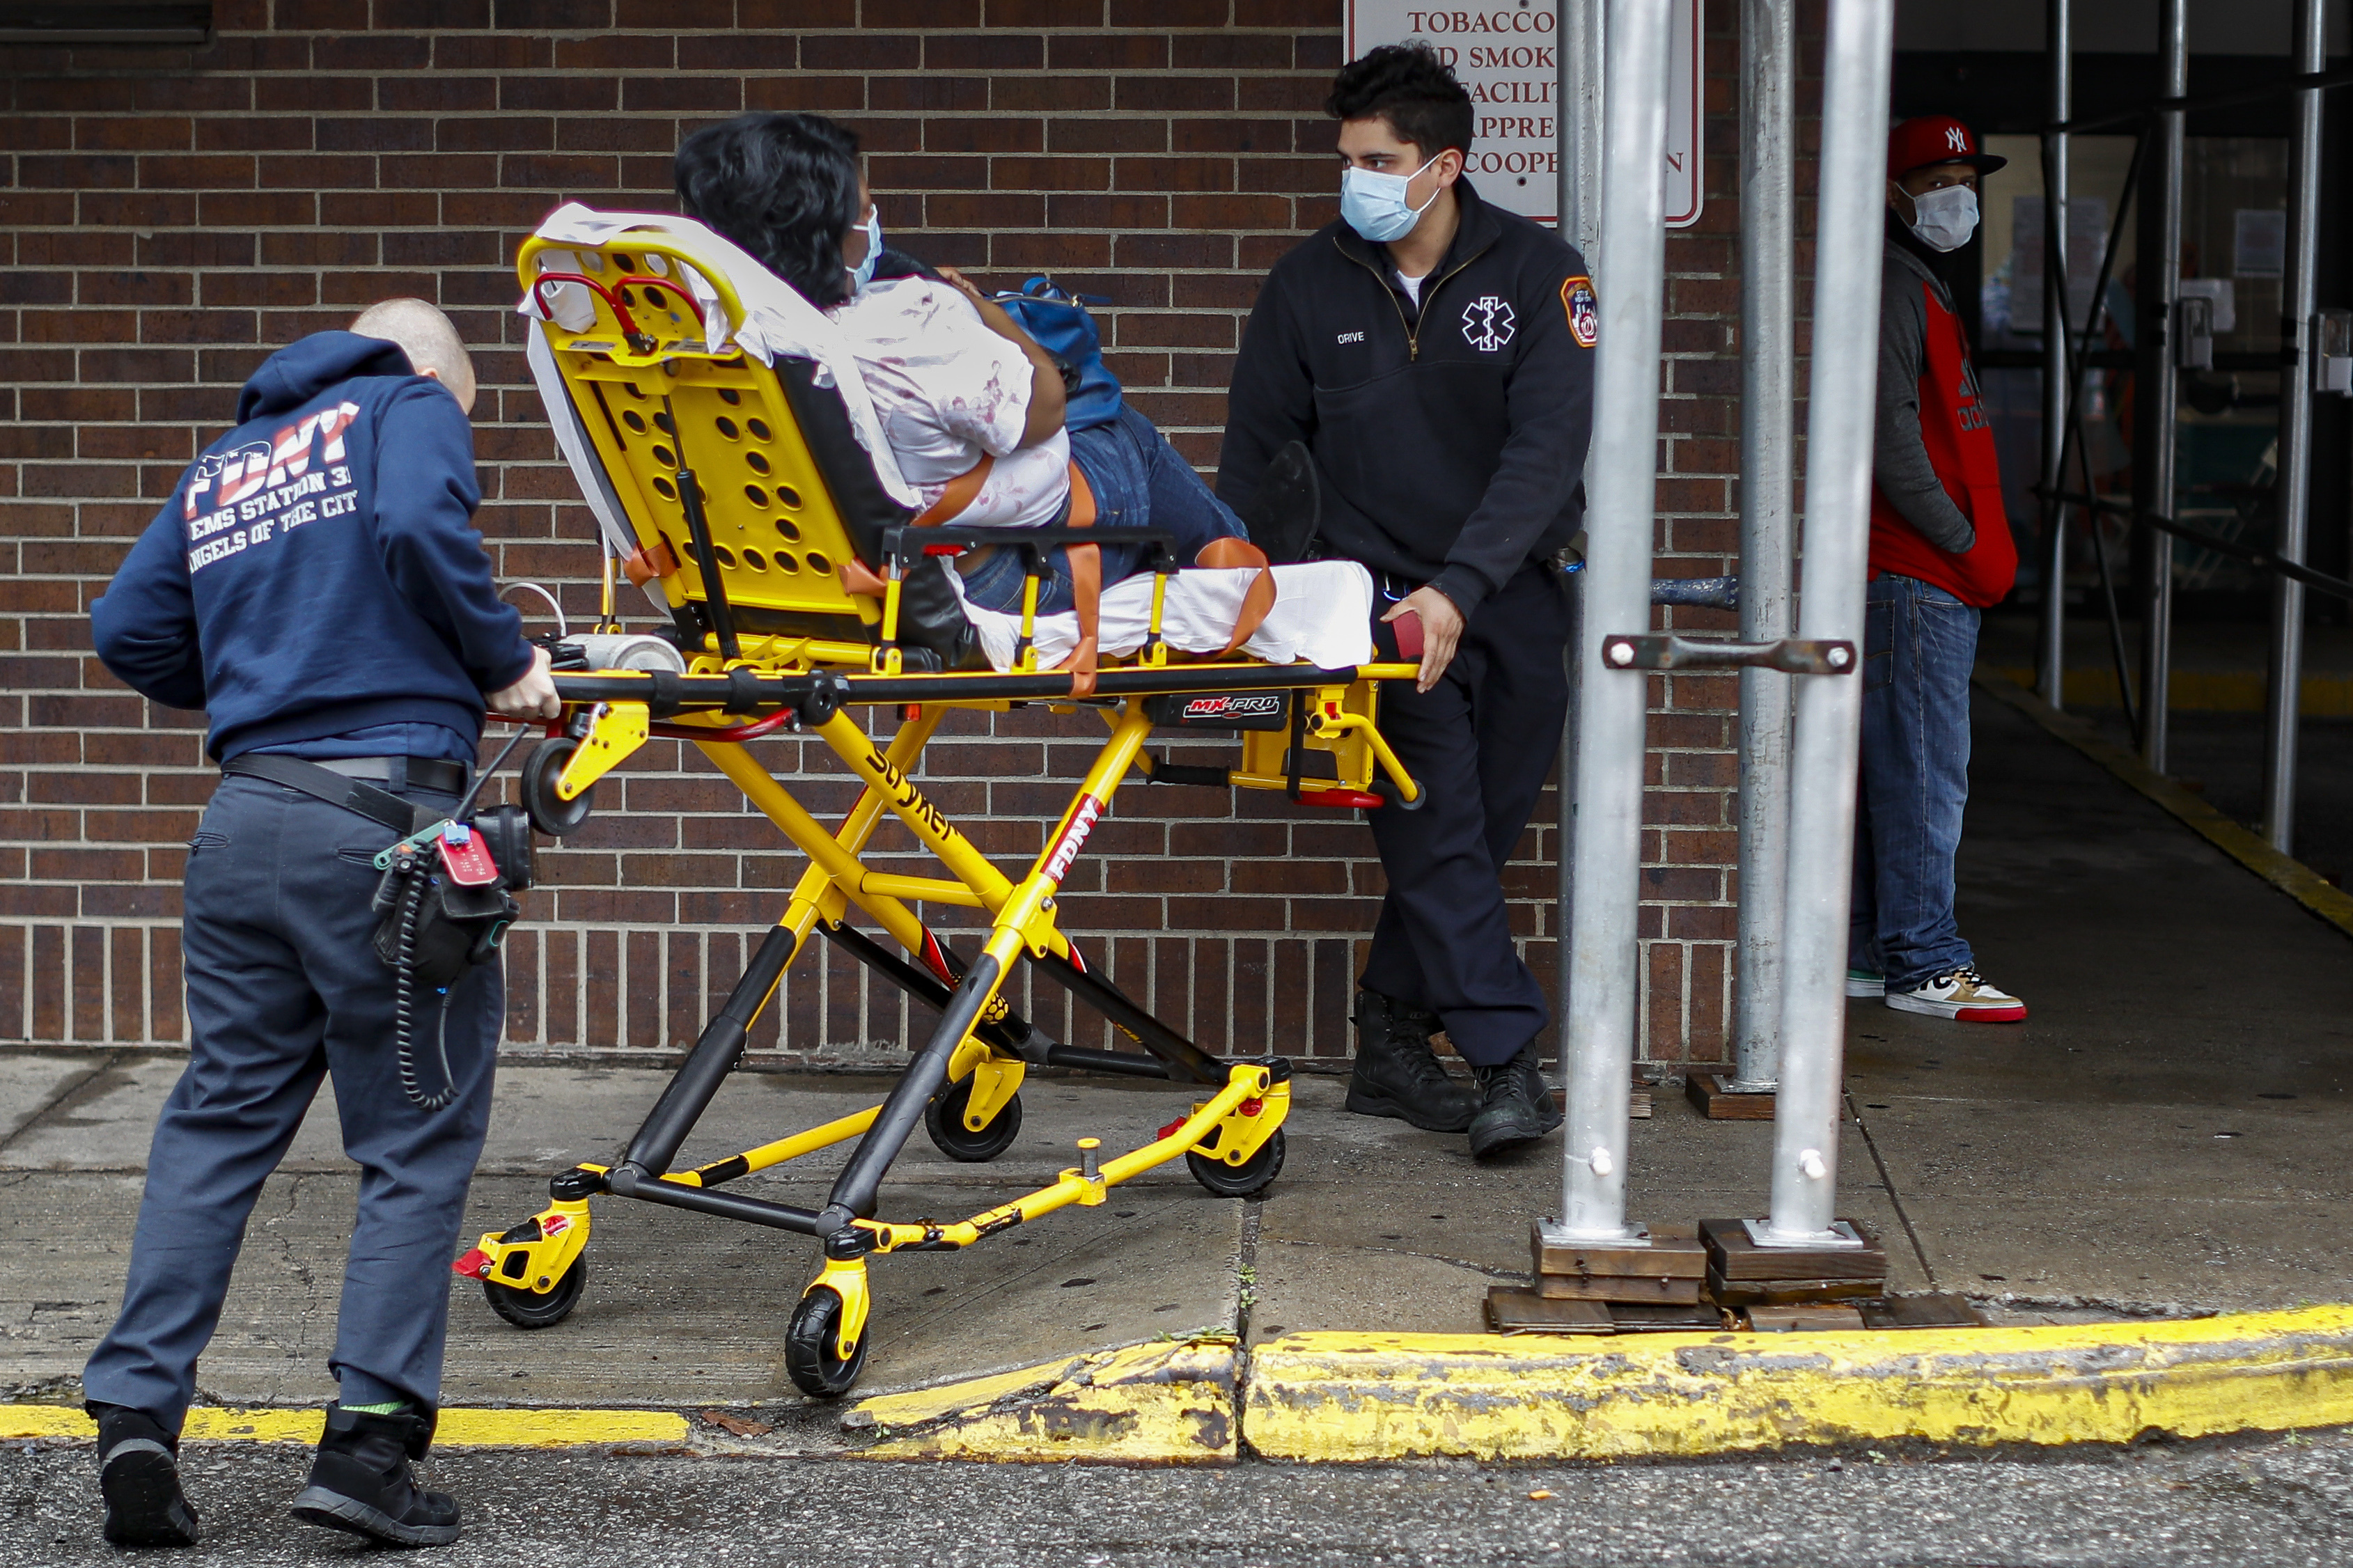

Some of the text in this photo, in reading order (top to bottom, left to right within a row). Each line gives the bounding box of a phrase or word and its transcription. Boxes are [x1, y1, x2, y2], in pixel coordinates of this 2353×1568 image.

[1407, 11, 1555, 33] TOBACCO
[1469, 46, 1556, 68] SMOK
[1471, 117, 1556, 139] PPRE
[186, 400, 360, 521] FDNY
[190, 507, 236, 541] EMS
[240, 471, 327, 521] STATION
[189, 489, 359, 574] NGELS OF THE CIT
[1188, 696, 1278, 713] MX-PRO
[1046, 797, 1098, 881] FDNY
